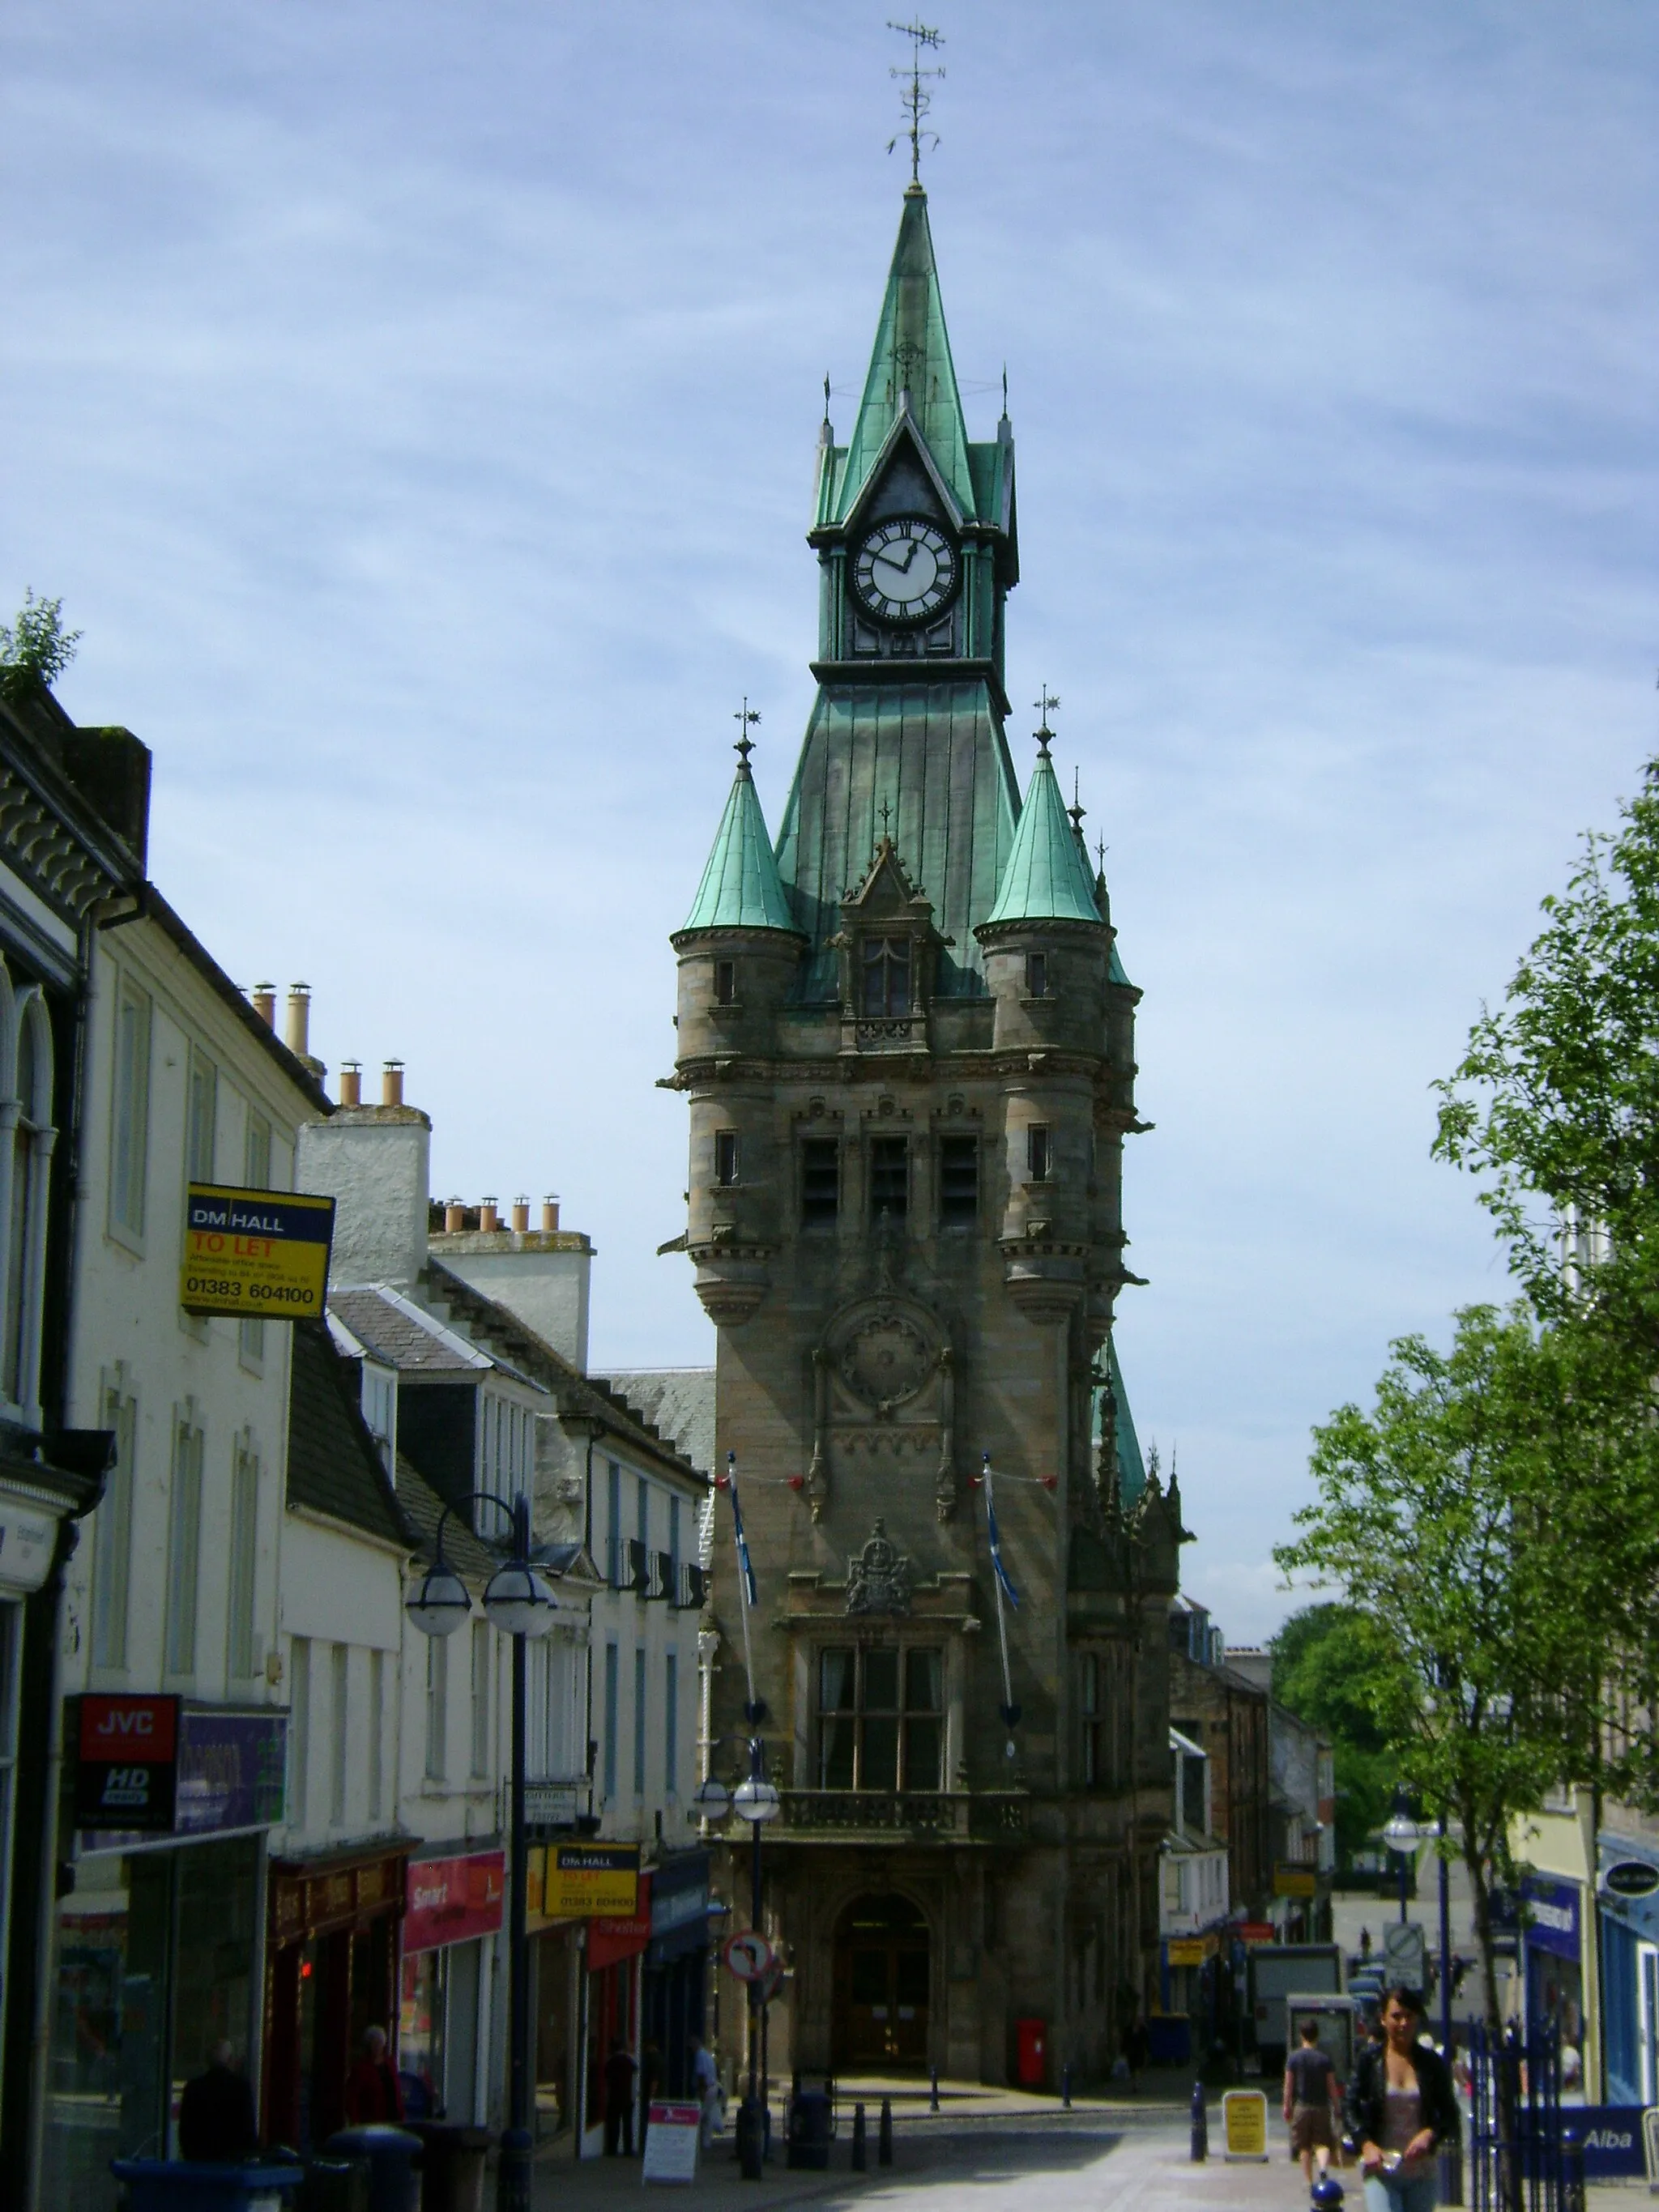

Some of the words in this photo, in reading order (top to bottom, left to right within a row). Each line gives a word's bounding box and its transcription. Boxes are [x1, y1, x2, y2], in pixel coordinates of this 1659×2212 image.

[193, 1210, 227, 1225] DM
[232, 1214, 284, 1232] HALL
[192, 1232, 225, 1252] TO
[234, 1237, 275, 1257] LET
[187, 1277, 241, 1296] 01383
[249, 1284, 313, 1303] 604100
[96, 1710, 154, 1734] JVC
[105, 1768, 149, 1788] HD
[107, 1792, 143, 1803] ready
[582, 1856, 612, 1867] HALL
[599, 1918, 646, 1935] Shelter
[1583, 2128, 1633, 2149] Alba
